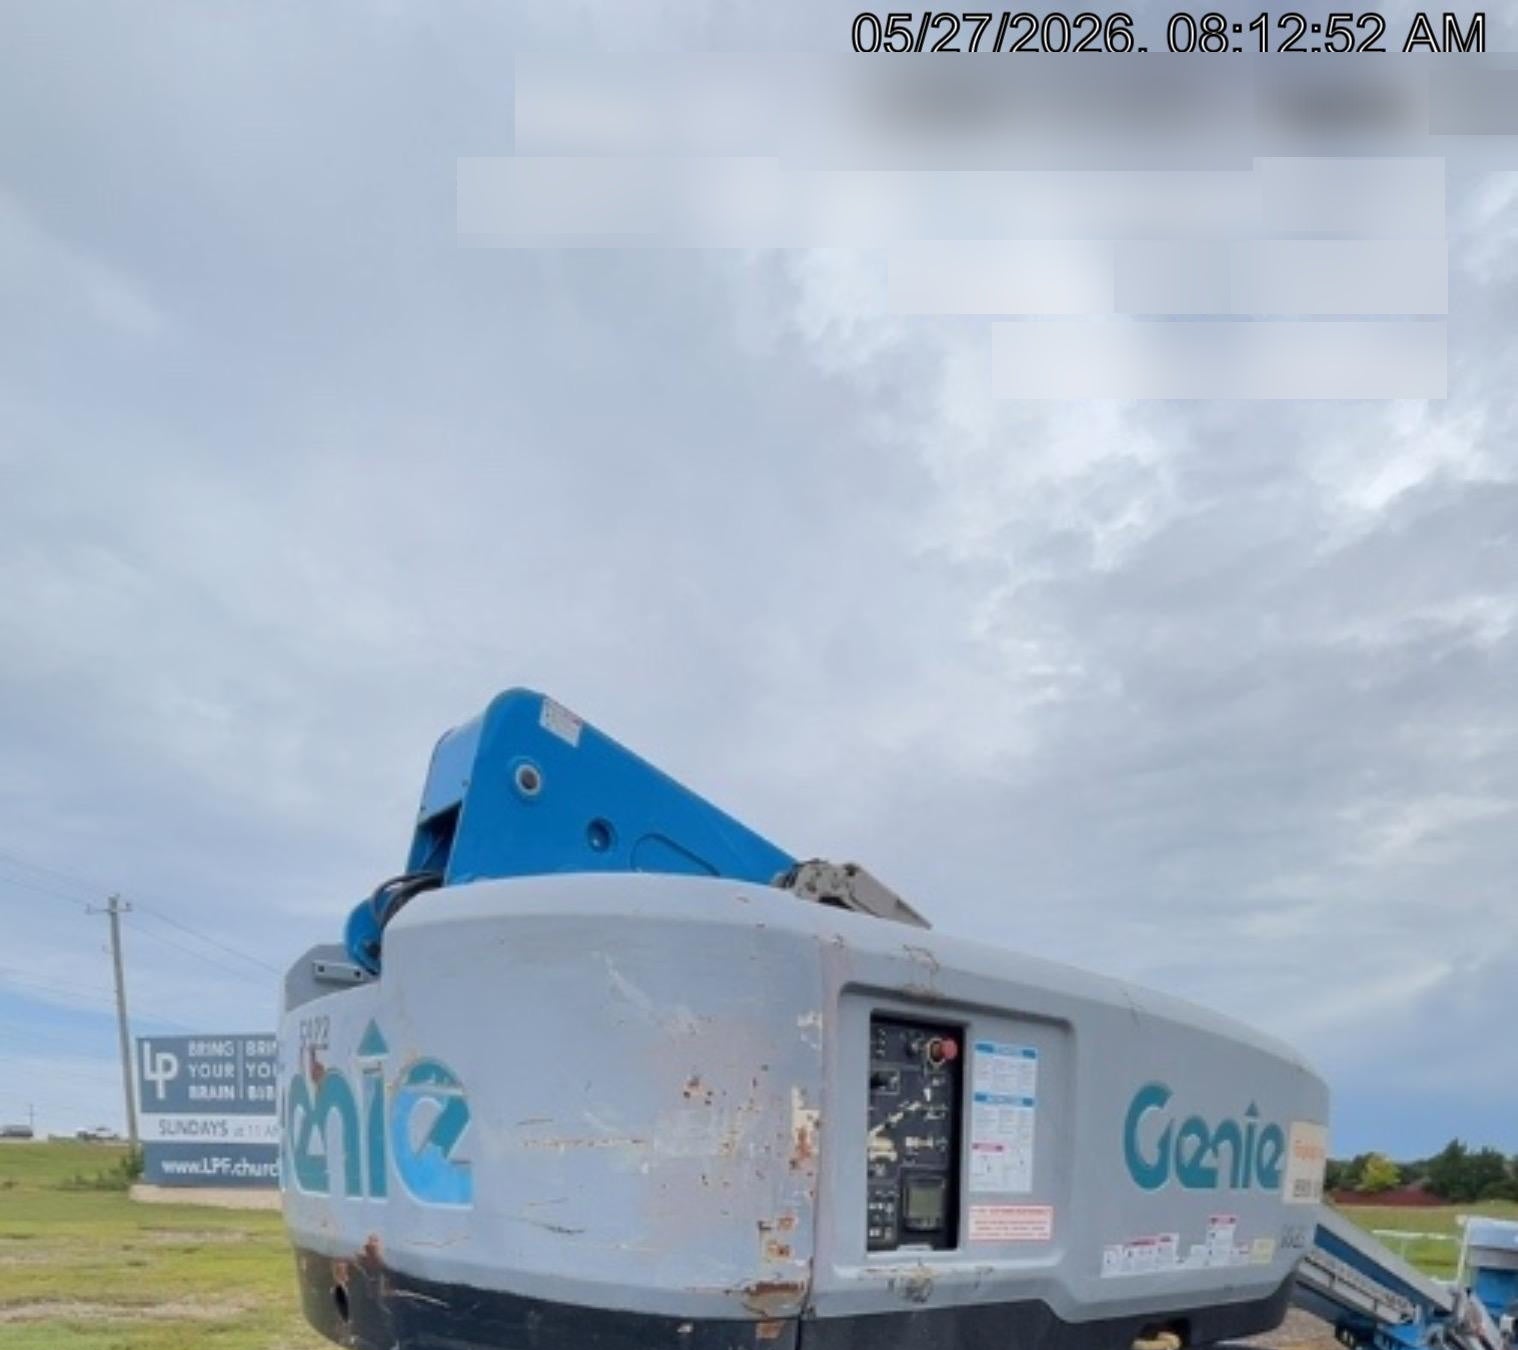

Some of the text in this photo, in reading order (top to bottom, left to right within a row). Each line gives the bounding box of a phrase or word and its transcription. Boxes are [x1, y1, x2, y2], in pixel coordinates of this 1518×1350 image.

[188, 1040, 234, 1057] BRING
[188, 1063, 234, 1078] YOUR
[188, 1085, 234, 1100] BRAIN
[288, 1014, 475, 1210] enie
[159, 1119, 229, 1136] SUNDAYS
[1124, 1080, 1285, 1190] Genie
